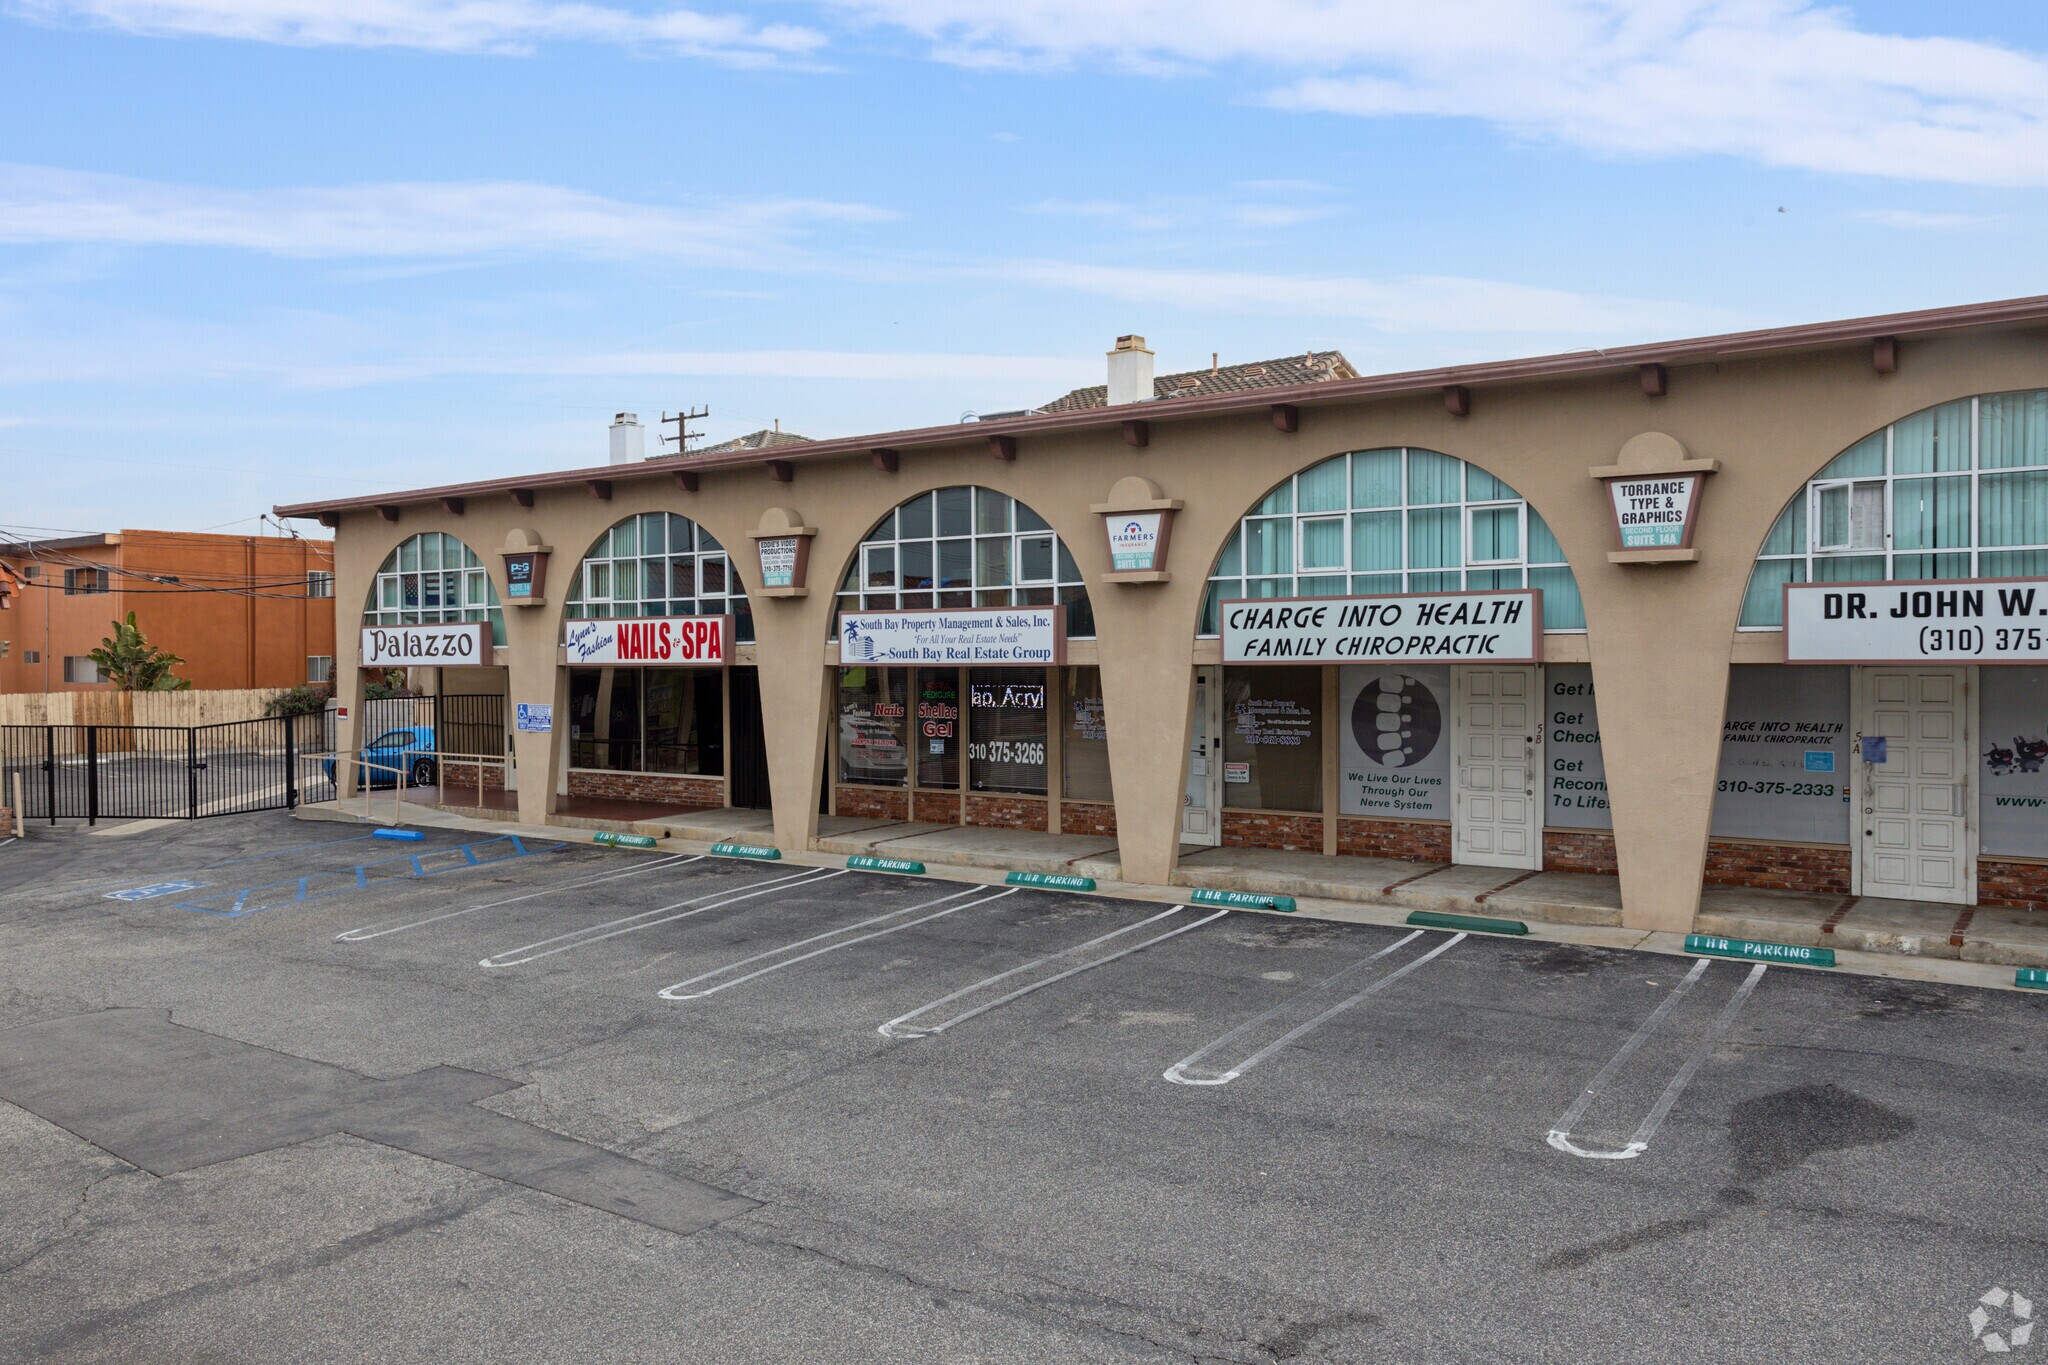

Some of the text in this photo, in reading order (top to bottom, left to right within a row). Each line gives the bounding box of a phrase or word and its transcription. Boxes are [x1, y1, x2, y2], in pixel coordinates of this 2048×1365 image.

[1621, 482, 1684, 497] TORRANCE
[1630, 496, 1674, 510] TYPE &
[1622, 510, 1682, 525] GRAPHICS
[1113, 533, 1154, 542] FARMERS
[1625, 527, 1653, 535] SECOND
[1627, 533, 1677, 546] SUITE 14A
[761, 547, 797, 555] PRODUCTIONS
[511, 562, 529, 572] PSG
[1117, 560, 1136, 569] SUITE
[1824, 588, 2048, 620] DR. JOHN W.
[1229, 600, 1523, 630] CHARGE INTO HEALTH
[860, 614, 1051, 633] South Bay Property Management & Sales, Inc.
[568, 621, 598, 648] Lynn's
[617, 621, 722, 660] NAILS & SPA
[930, 634, 941, 643] All
[941, 634, 958, 643] Your
[959, 634, 974, 643] Real
[975, 633, 998, 643] Estate
[1919, 625, 2048, 655] (310) 375
[370, 629, 473, 662] Palazzo
[578, 634, 614, 662] Fashion
[1243, 634, 1500, 657] FAMILY CHIROPRACTIC
[889, 646, 1051, 662] South Bay Real Estate Group
[922, 690, 957, 699] PEDICURE
[1553, 683, 1584, 696] Get
[874, 702, 905, 717] Nails
[918, 702, 958, 720] Shellac
[1553, 711, 1584, 725] Get
[923, 721, 954, 738] Gel
[1537, 723, 1543, 734] 5
[1724, 721, 1844, 734] ARGE INTO HEALTH
[1553, 729, 1602, 744] Check
[1723, 733, 1835, 745] FAMILY CHIROPRACTIC
[969, 741, 1044, 765] 310 375-3266
[1852, 743, 1861, 754] A
[1553, 758, 1585, 772] Get
[1348, 772, 1442, 786] We Live Our Lives
[1553, 777, 1608, 791] Recon
[1361, 785, 1428, 798] Through Our
[1717, 780, 1835, 797] 310-375-2333
[1360, 797, 1433, 811] Nerve System
[1553, 794, 1572, 807] To
[617, 833, 644, 845] PARKING
[722, 844, 732, 853] HR
[738, 846, 769, 856] PARKING
[860, 858, 873, 867] HR
[877, 859, 911, 870] PARKING
[1024, 873, 1039, 883] HR
[1045, 874, 1084, 887] PARKING
[1204, 889, 1222, 901] HR
[1228, 891, 1274, 905] PARKING
[1706, 938, 1729, 950] HR
[1744, 942, 1811, 959] PARKING
